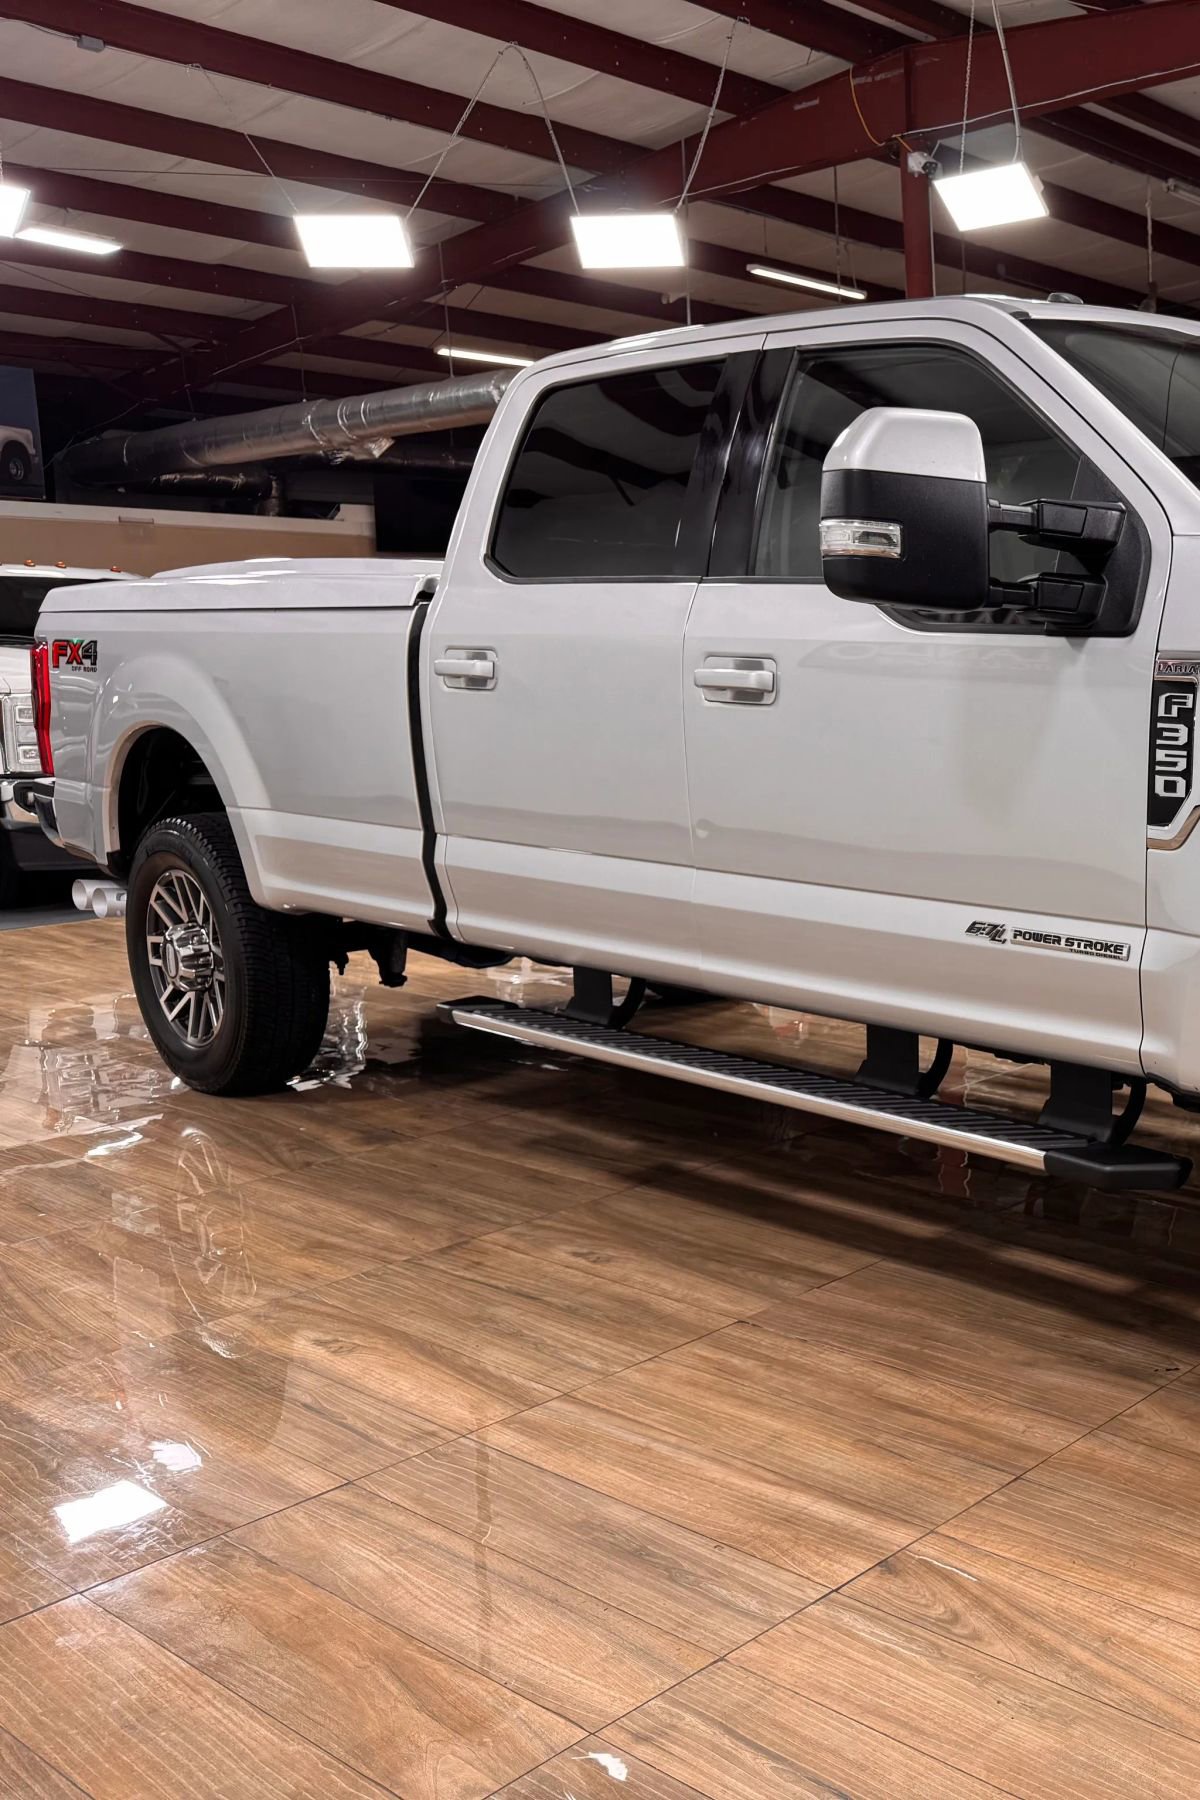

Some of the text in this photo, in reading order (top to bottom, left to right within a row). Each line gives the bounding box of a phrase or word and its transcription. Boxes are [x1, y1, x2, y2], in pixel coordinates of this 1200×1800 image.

[52, 638, 98, 669] FX4
[1154, 692, 1195, 798] F350
[1013, 929, 1063, 946] POWER
[1065, 937, 1125, 955] STROKE
[1069, 948, 1095, 956] TURBO
